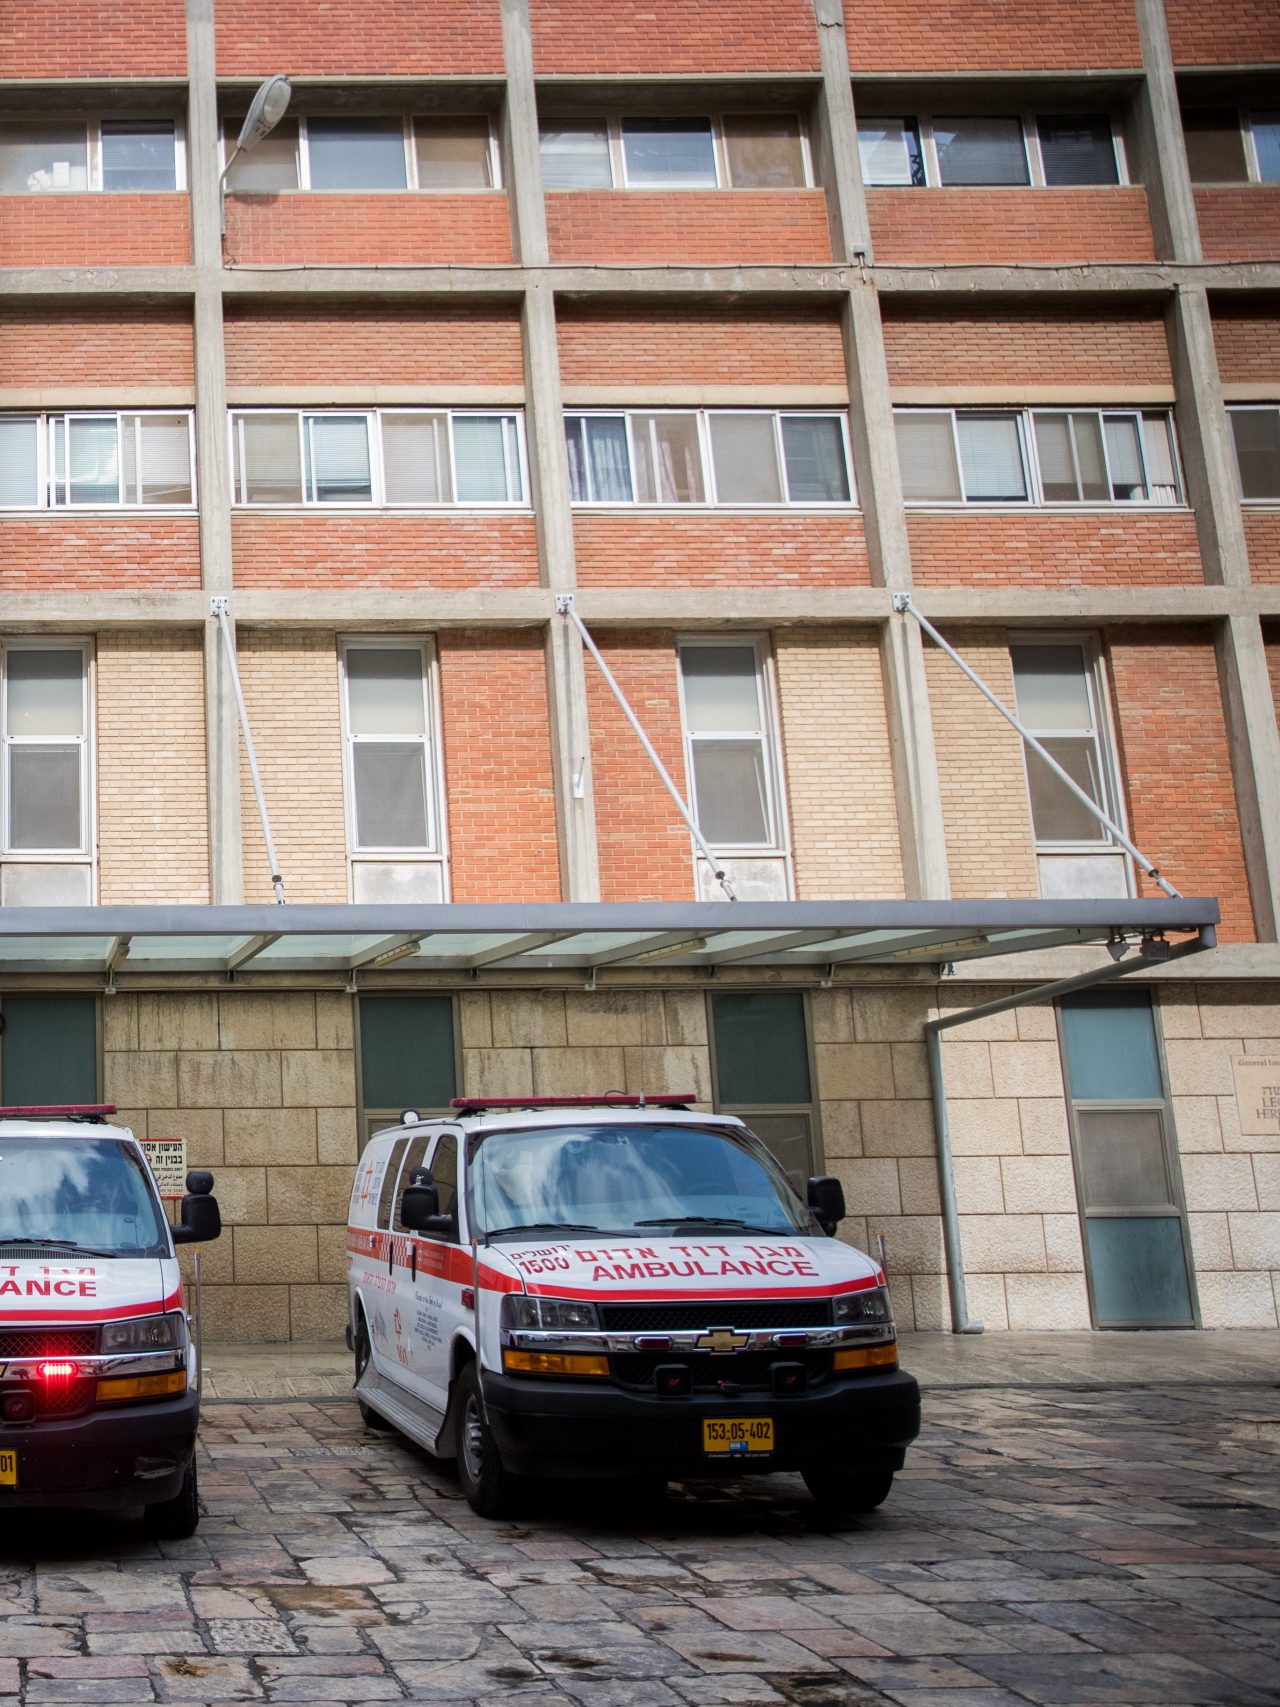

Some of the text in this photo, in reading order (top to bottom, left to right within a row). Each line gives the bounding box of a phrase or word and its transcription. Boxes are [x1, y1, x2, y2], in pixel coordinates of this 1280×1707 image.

[1263, 1097, 1280, 1107] LE
[159, 1143, 183, 1154] העישון
[155, 1155, 183, 1167] בבנין זה
[510, 1244, 570, 1260] ירושלים
[573, 1245, 805, 1263] מגן דוד אדום
[39, 1266, 97, 1279] מגן
[518, 1257, 570, 1276] 1500
[592, 1261, 820, 1281] AMBULANCE
